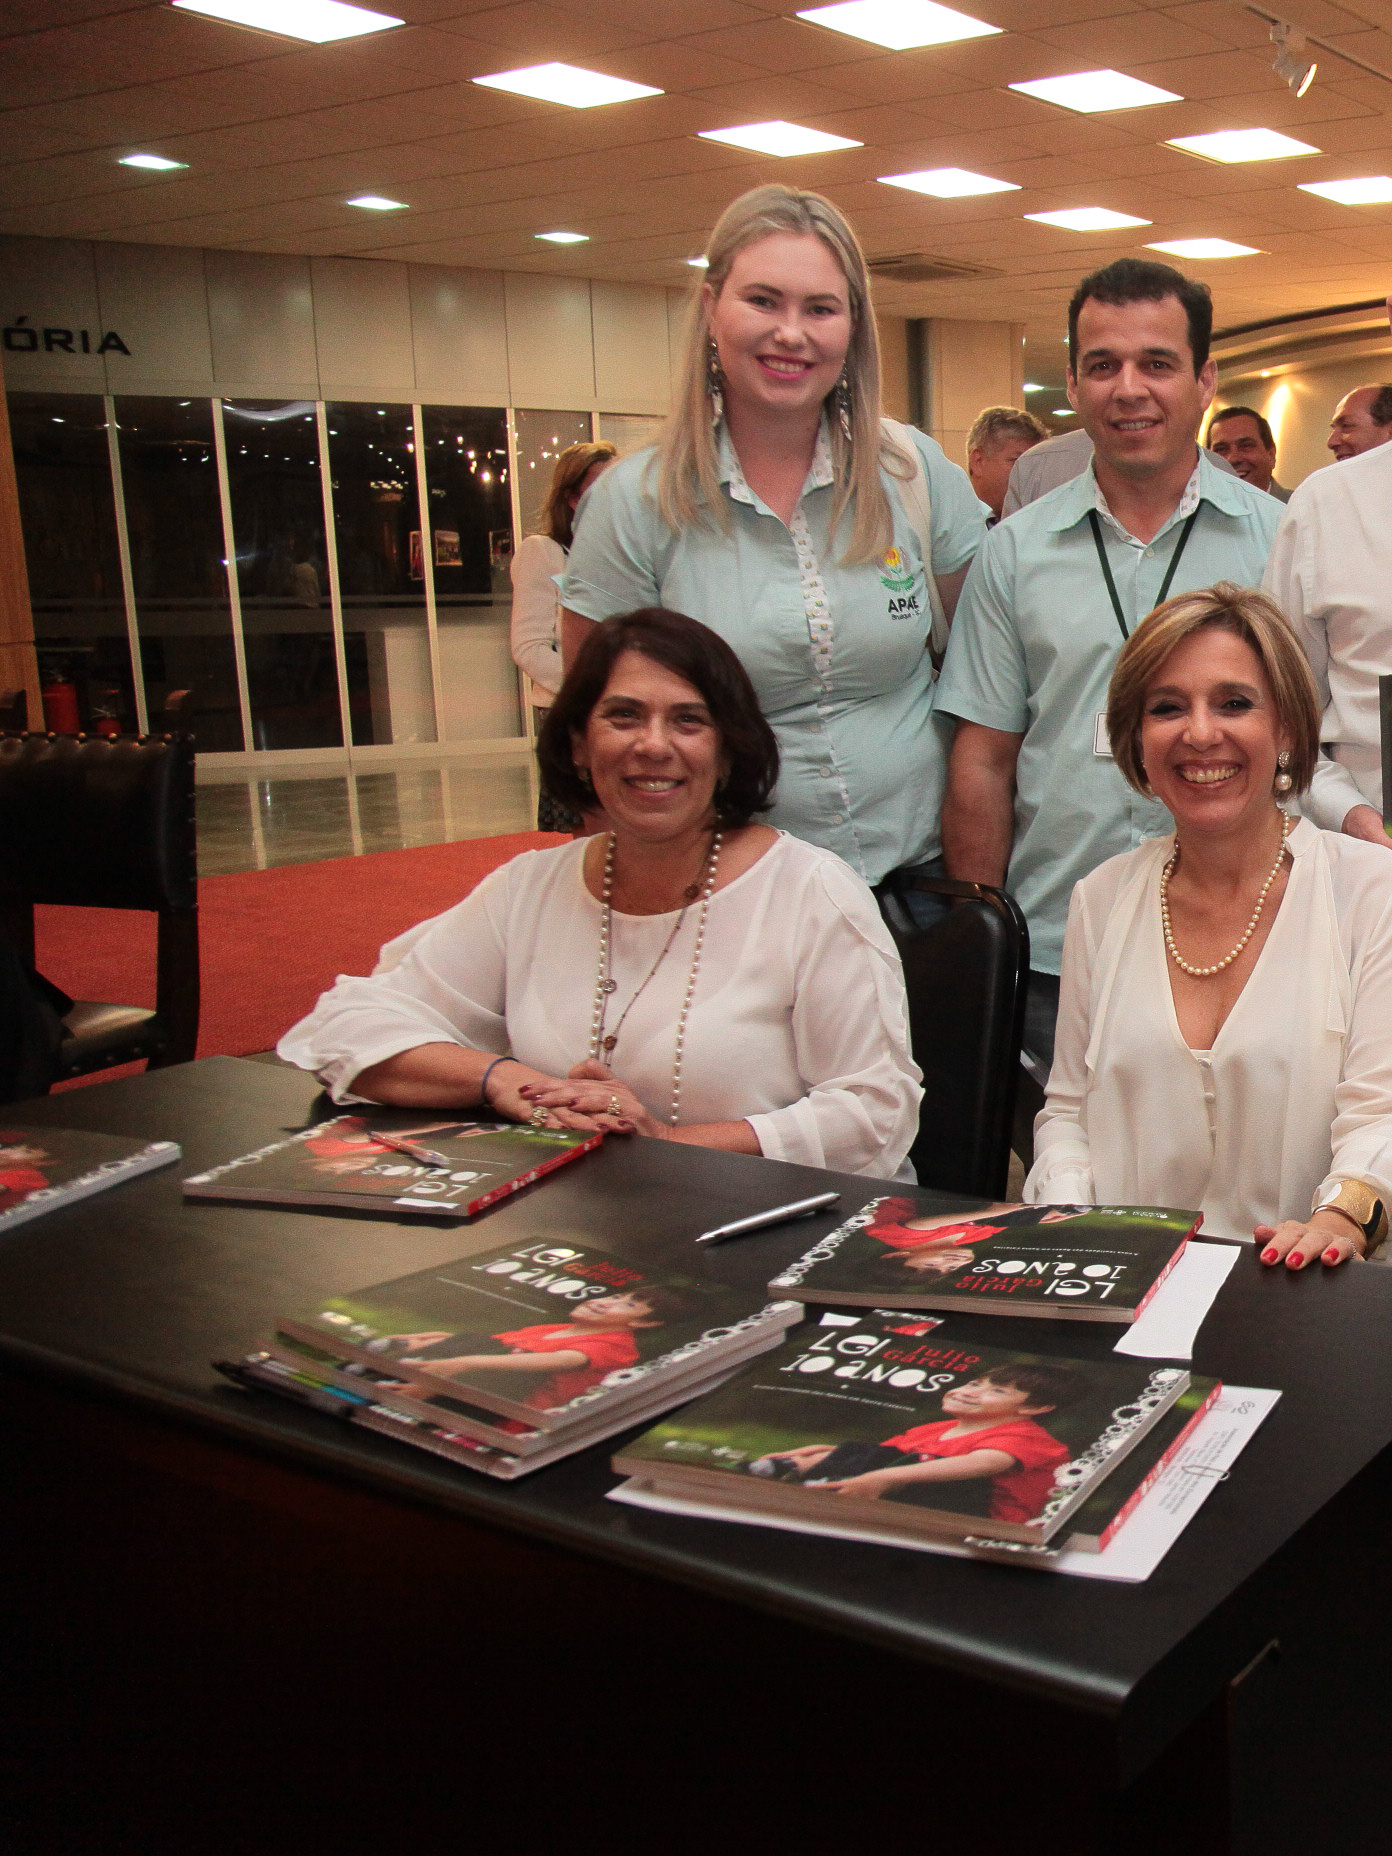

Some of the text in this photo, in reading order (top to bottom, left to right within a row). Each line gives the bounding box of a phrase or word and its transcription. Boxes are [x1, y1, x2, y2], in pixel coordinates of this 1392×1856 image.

[888, 596, 919, 612] APAE
[471, 1258, 523, 1274] 10
[1082, 1264, 1128, 1279] 10
[778, 1353, 836, 1373] 10
